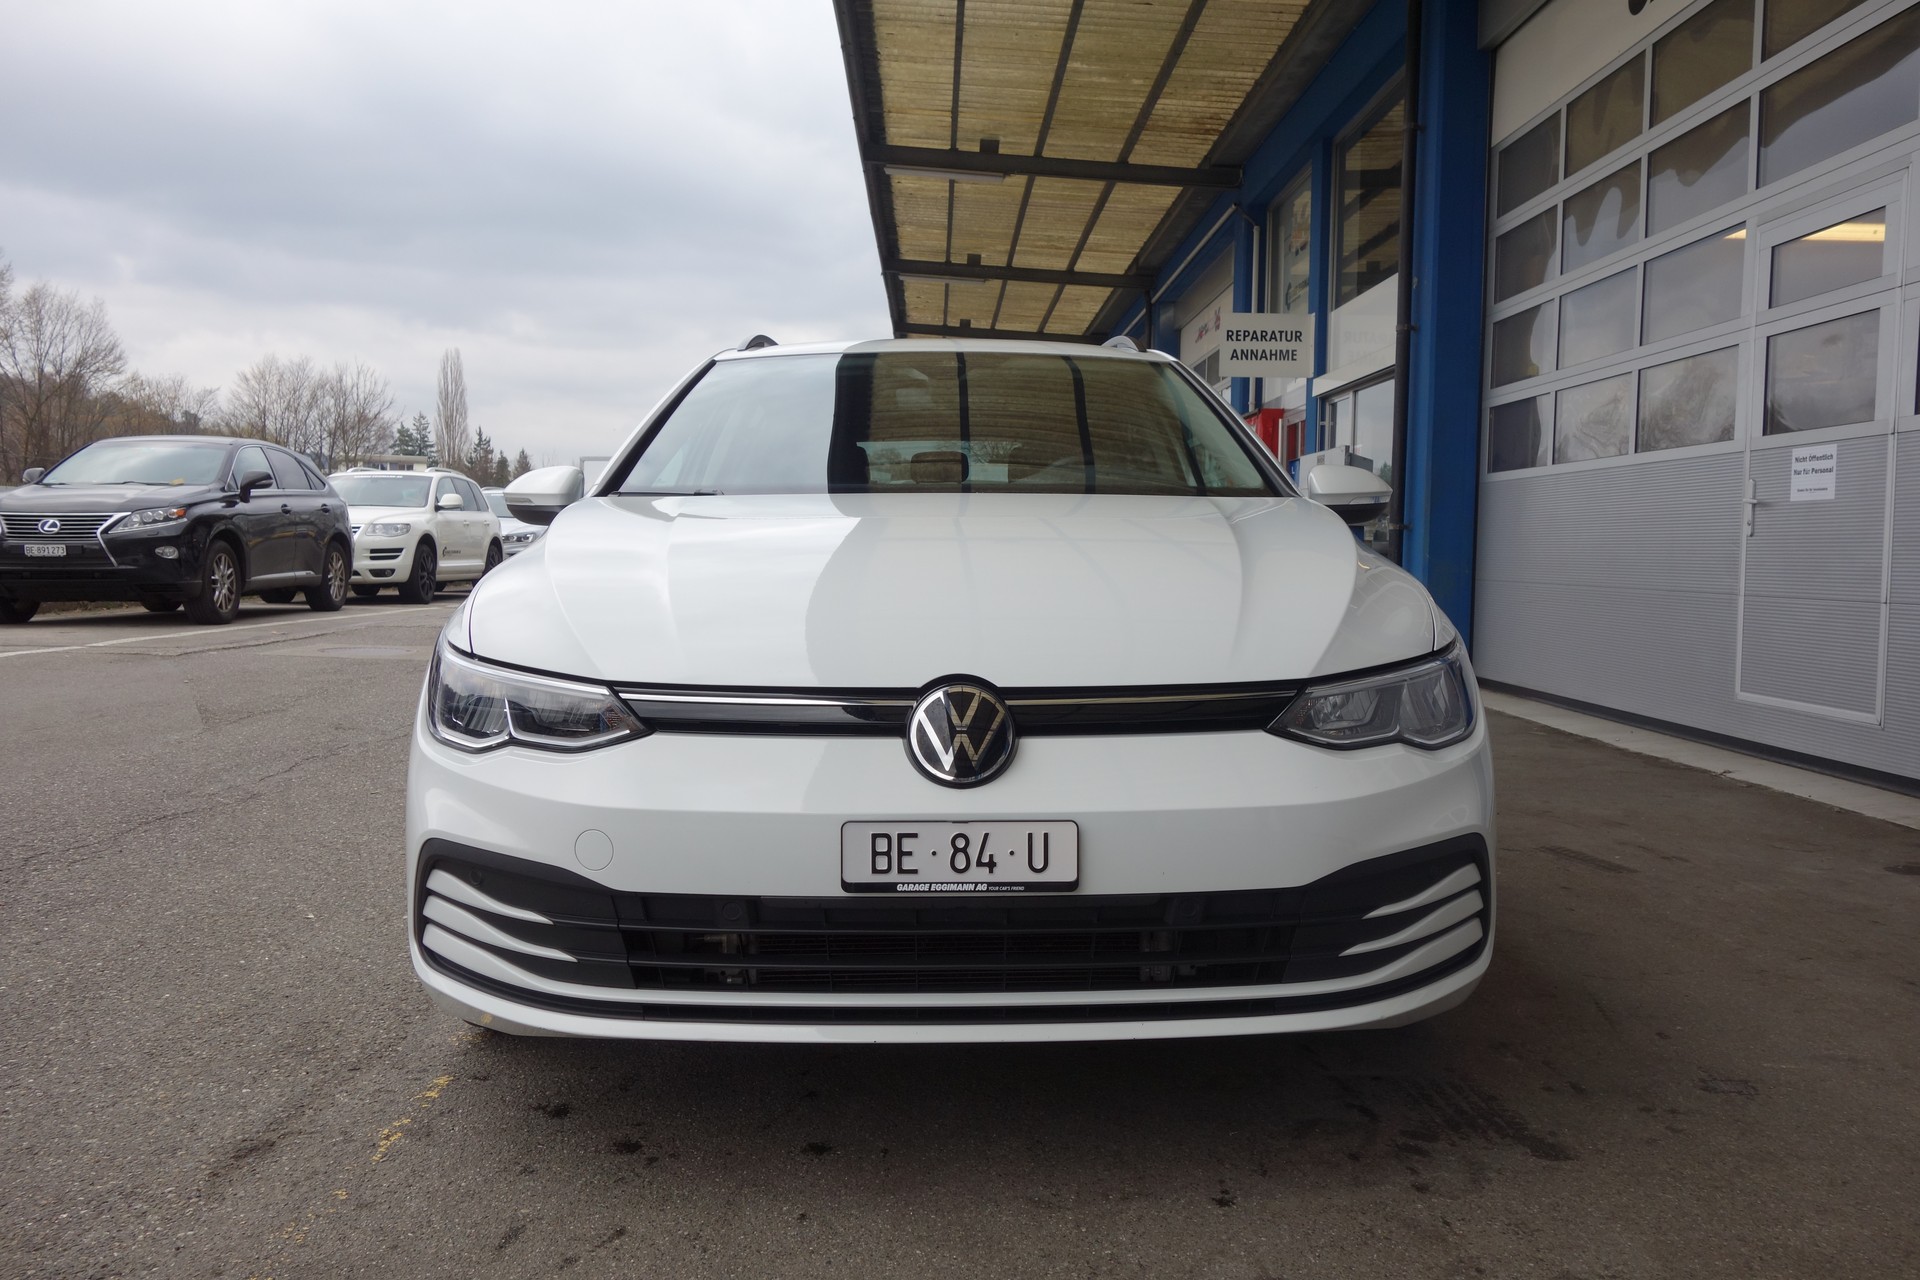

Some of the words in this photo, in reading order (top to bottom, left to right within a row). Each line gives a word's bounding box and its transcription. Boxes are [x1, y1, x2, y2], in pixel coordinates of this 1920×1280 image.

[1226, 329, 1303, 342] REPARATUR
[1230, 348, 1297, 361] ANNAHME
[897, 883, 930, 892] GARAGE
[930, 883, 976, 892] EGGIMANN
[975, 883, 988, 892] AG
